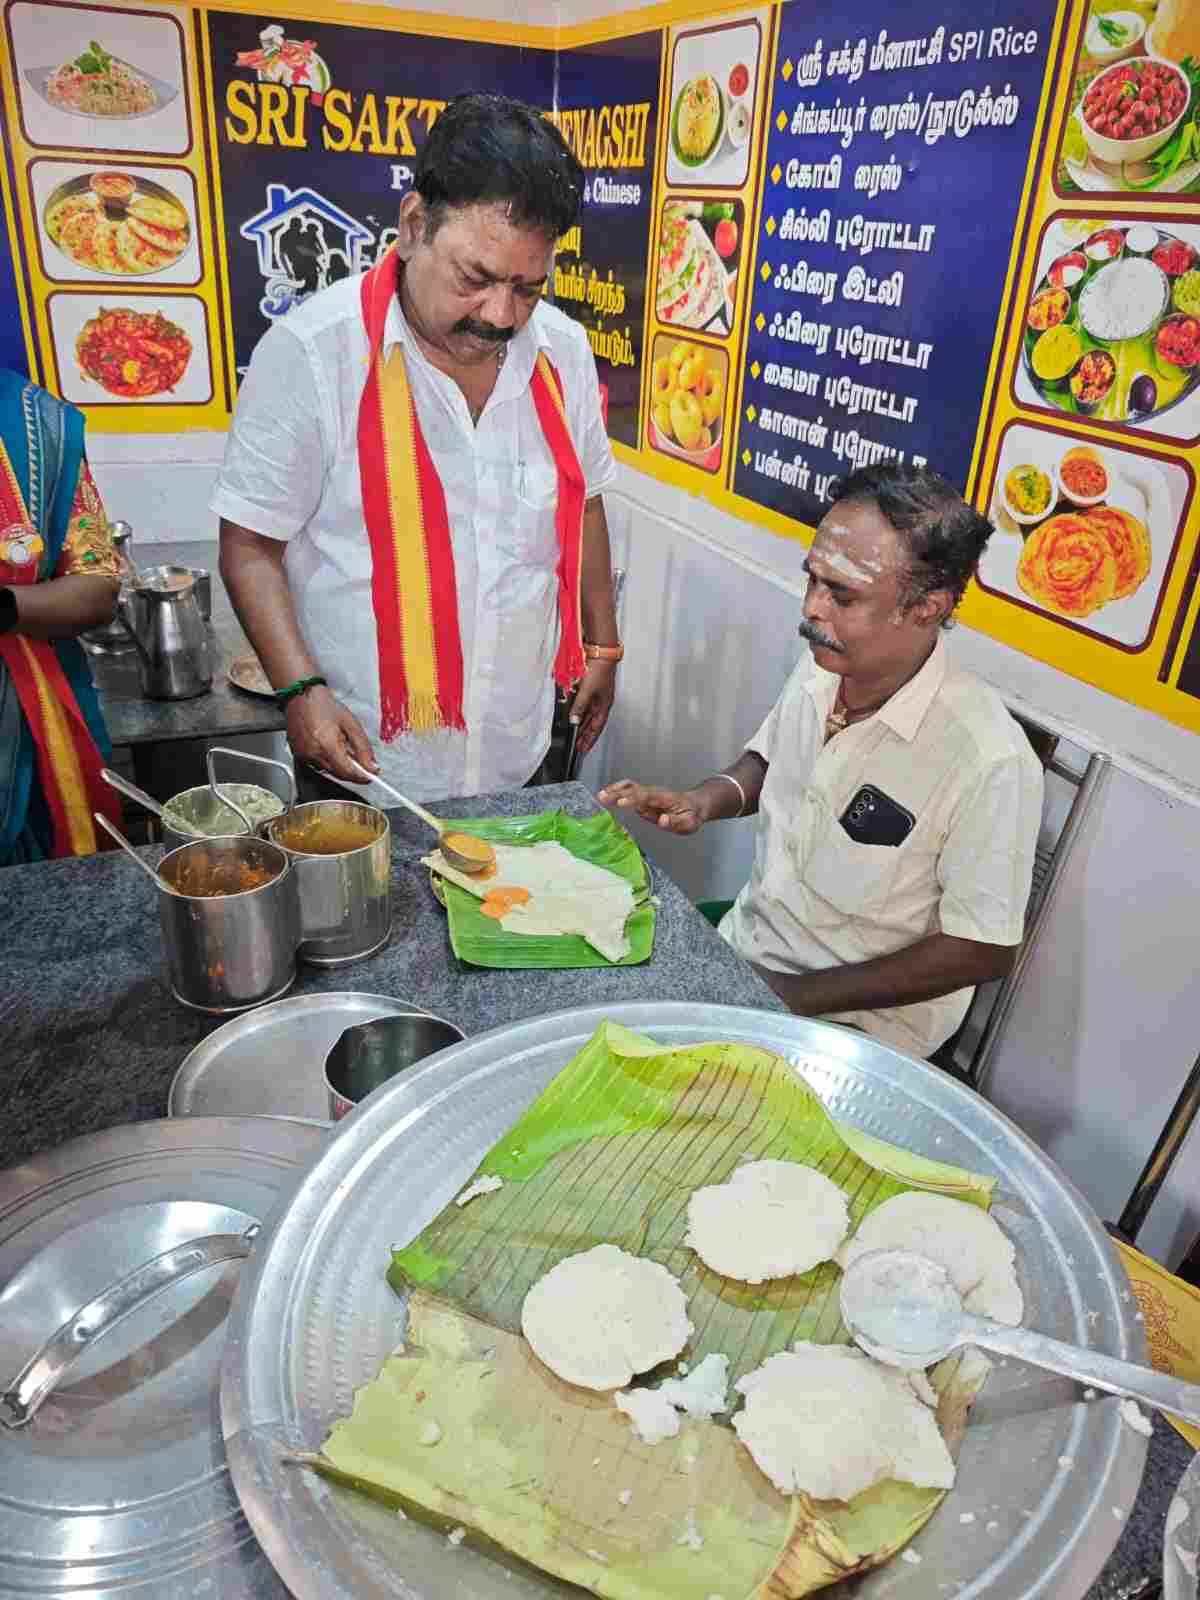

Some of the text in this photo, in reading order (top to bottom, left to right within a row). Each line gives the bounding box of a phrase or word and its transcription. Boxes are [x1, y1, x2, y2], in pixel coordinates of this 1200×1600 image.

[826, 37, 867, 84] சக்தி
[869, 25, 945, 72] மீனாட்சி
[948, 29, 985, 62] SPI
[988, 26, 1039, 58] Rice
[225, 80, 312, 148] SRI
[322, 88, 448, 157] SAKT
[790, 95, 867, 149] சிங்கப்பூர்
[593, 176, 641, 206] Chinese
[785, 154, 902, 199] கோபி ரைஸ்
[779, 206, 937, 256] சில்லி புரோட்டா
[773, 260, 904, 307] ஃபிரை இட்லி
[768, 310, 934, 369] ஃபிரை புரோட்டா
[763, 362, 919, 423] கைமா புரோட்டா
[758, 406, 829, 448] காளான்
[754, 449, 811, 490] பன்னீர்
